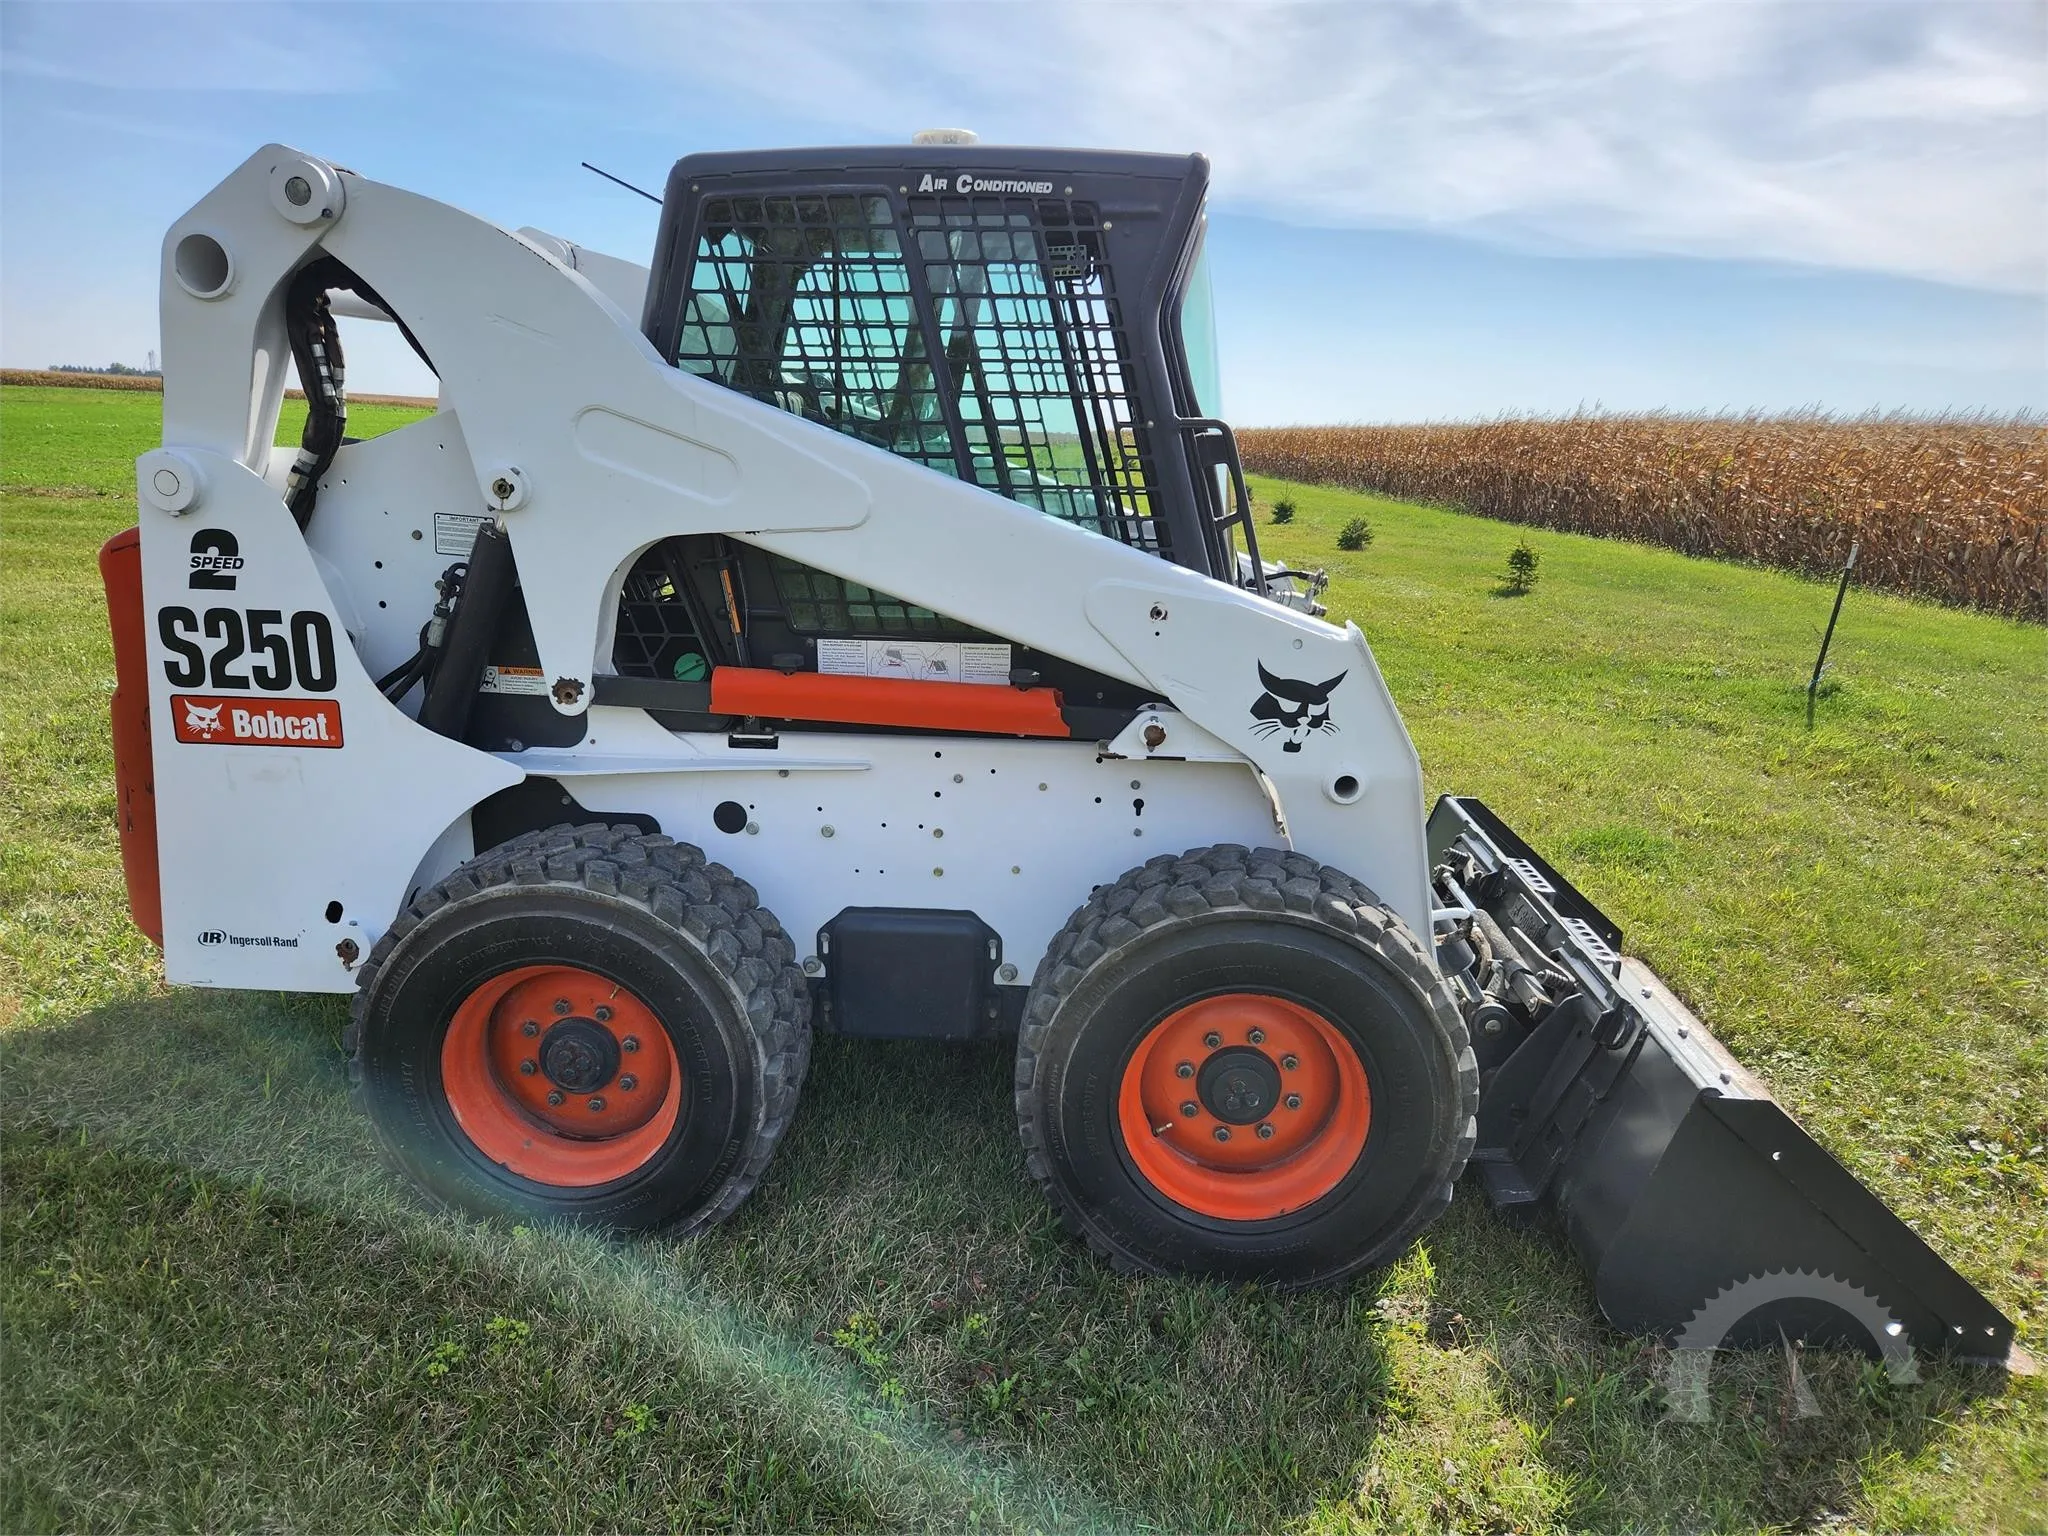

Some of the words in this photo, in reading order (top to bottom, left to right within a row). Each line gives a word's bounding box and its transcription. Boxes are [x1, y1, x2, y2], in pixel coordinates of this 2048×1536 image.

[188, 528, 239, 591] 2
[189, 555, 245, 571] SPEED
[157, 606, 338, 693] S250
[512, 668, 544, 676] WARNING
[231, 709, 329, 741] Bobcat
